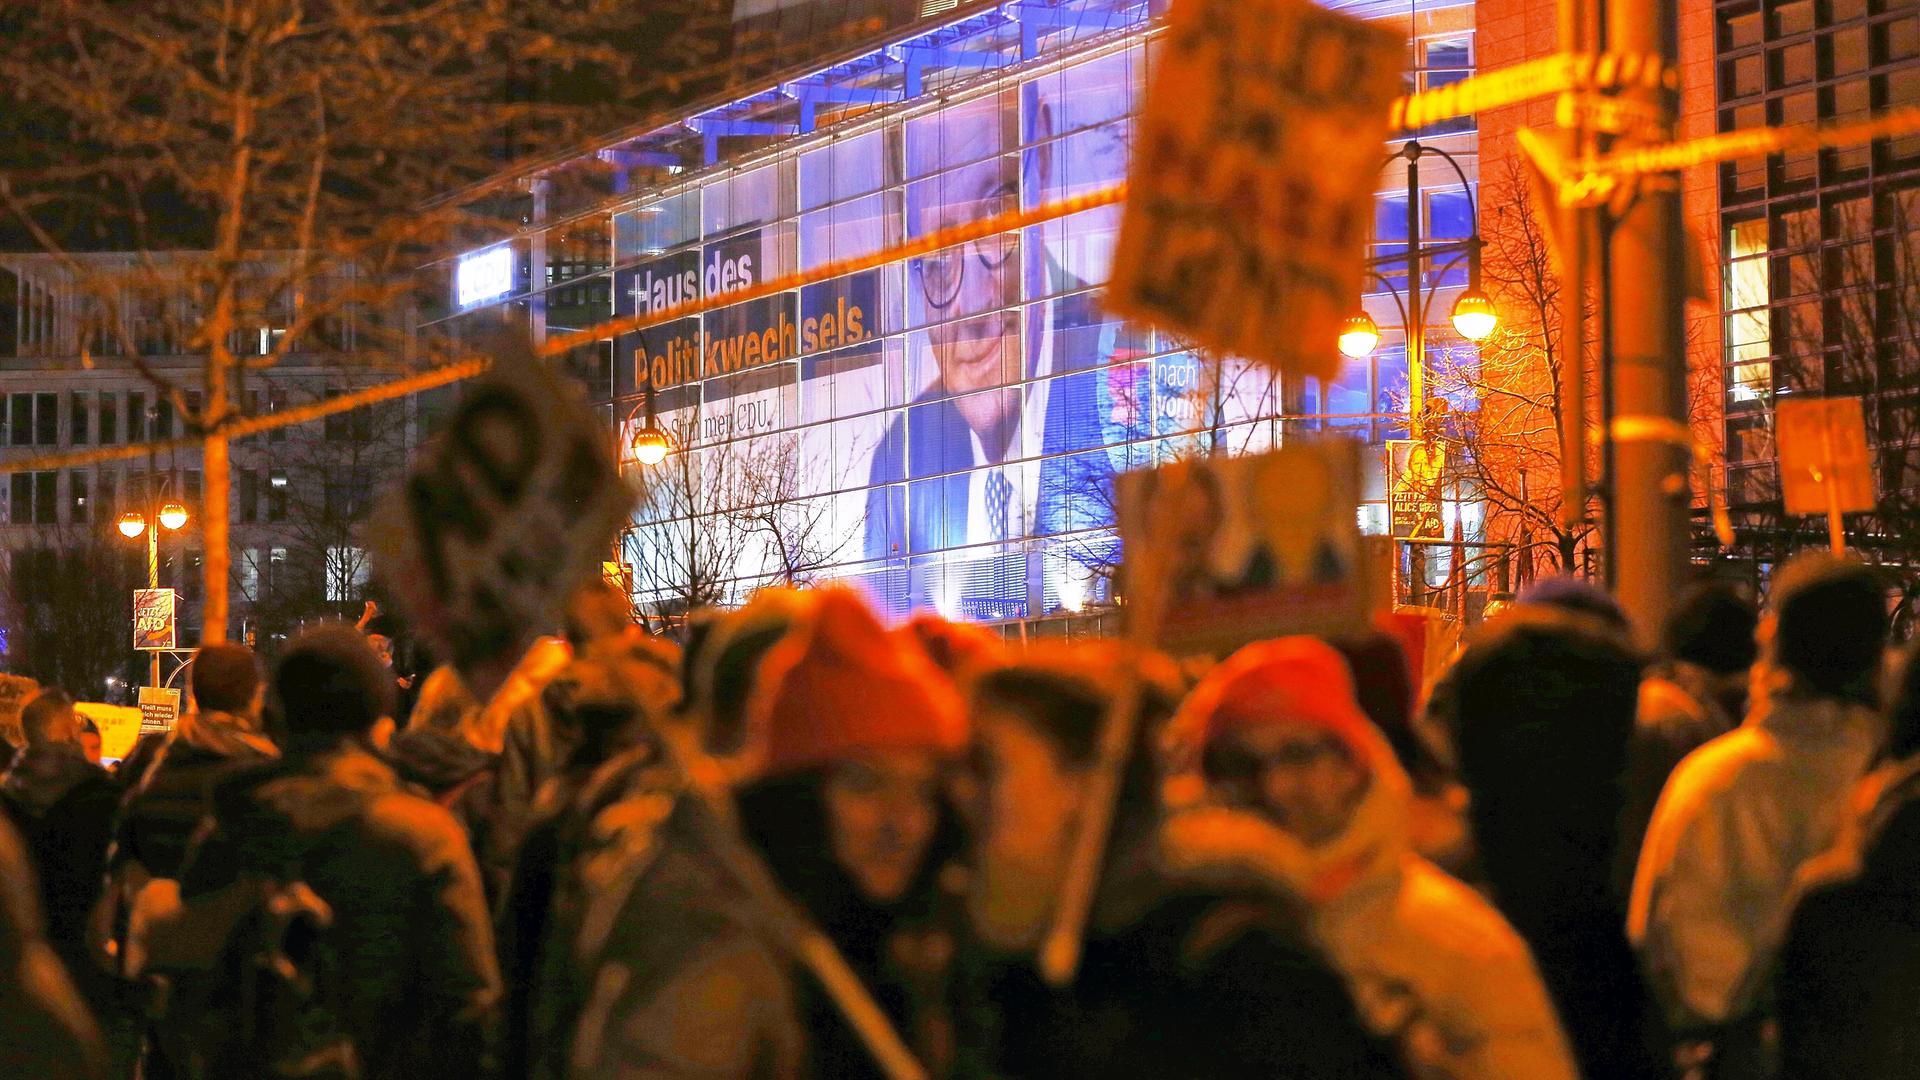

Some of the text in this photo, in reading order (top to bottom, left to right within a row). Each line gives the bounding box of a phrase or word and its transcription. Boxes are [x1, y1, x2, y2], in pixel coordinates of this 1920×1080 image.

[634, 250, 753, 319] Haus des
[634, 296, 873, 392] Politikwechsels.
[1158, 359, 1196, 388] nach
[737, 399, 772, 432] CDU.
[1394, 502, 1417, 513] ALICE
